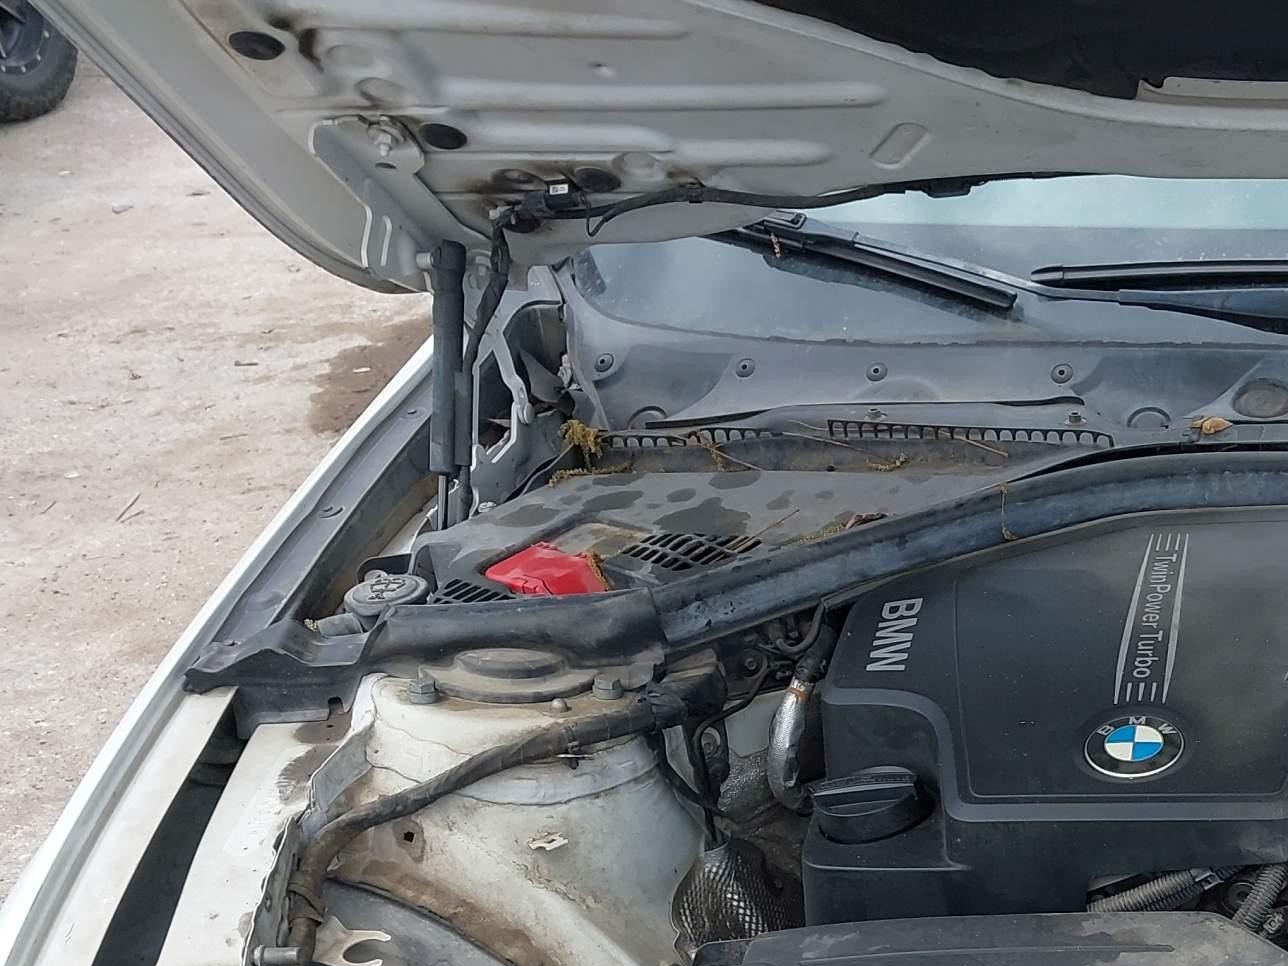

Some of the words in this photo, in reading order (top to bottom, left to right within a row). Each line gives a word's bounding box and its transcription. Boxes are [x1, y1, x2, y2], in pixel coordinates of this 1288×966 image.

[1141, 552, 1177, 629] TwinPower
[865, 597, 924, 672] BMW
[1132, 630, 1163, 679] Turbo
[1096, 715, 1178, 736] BMW
